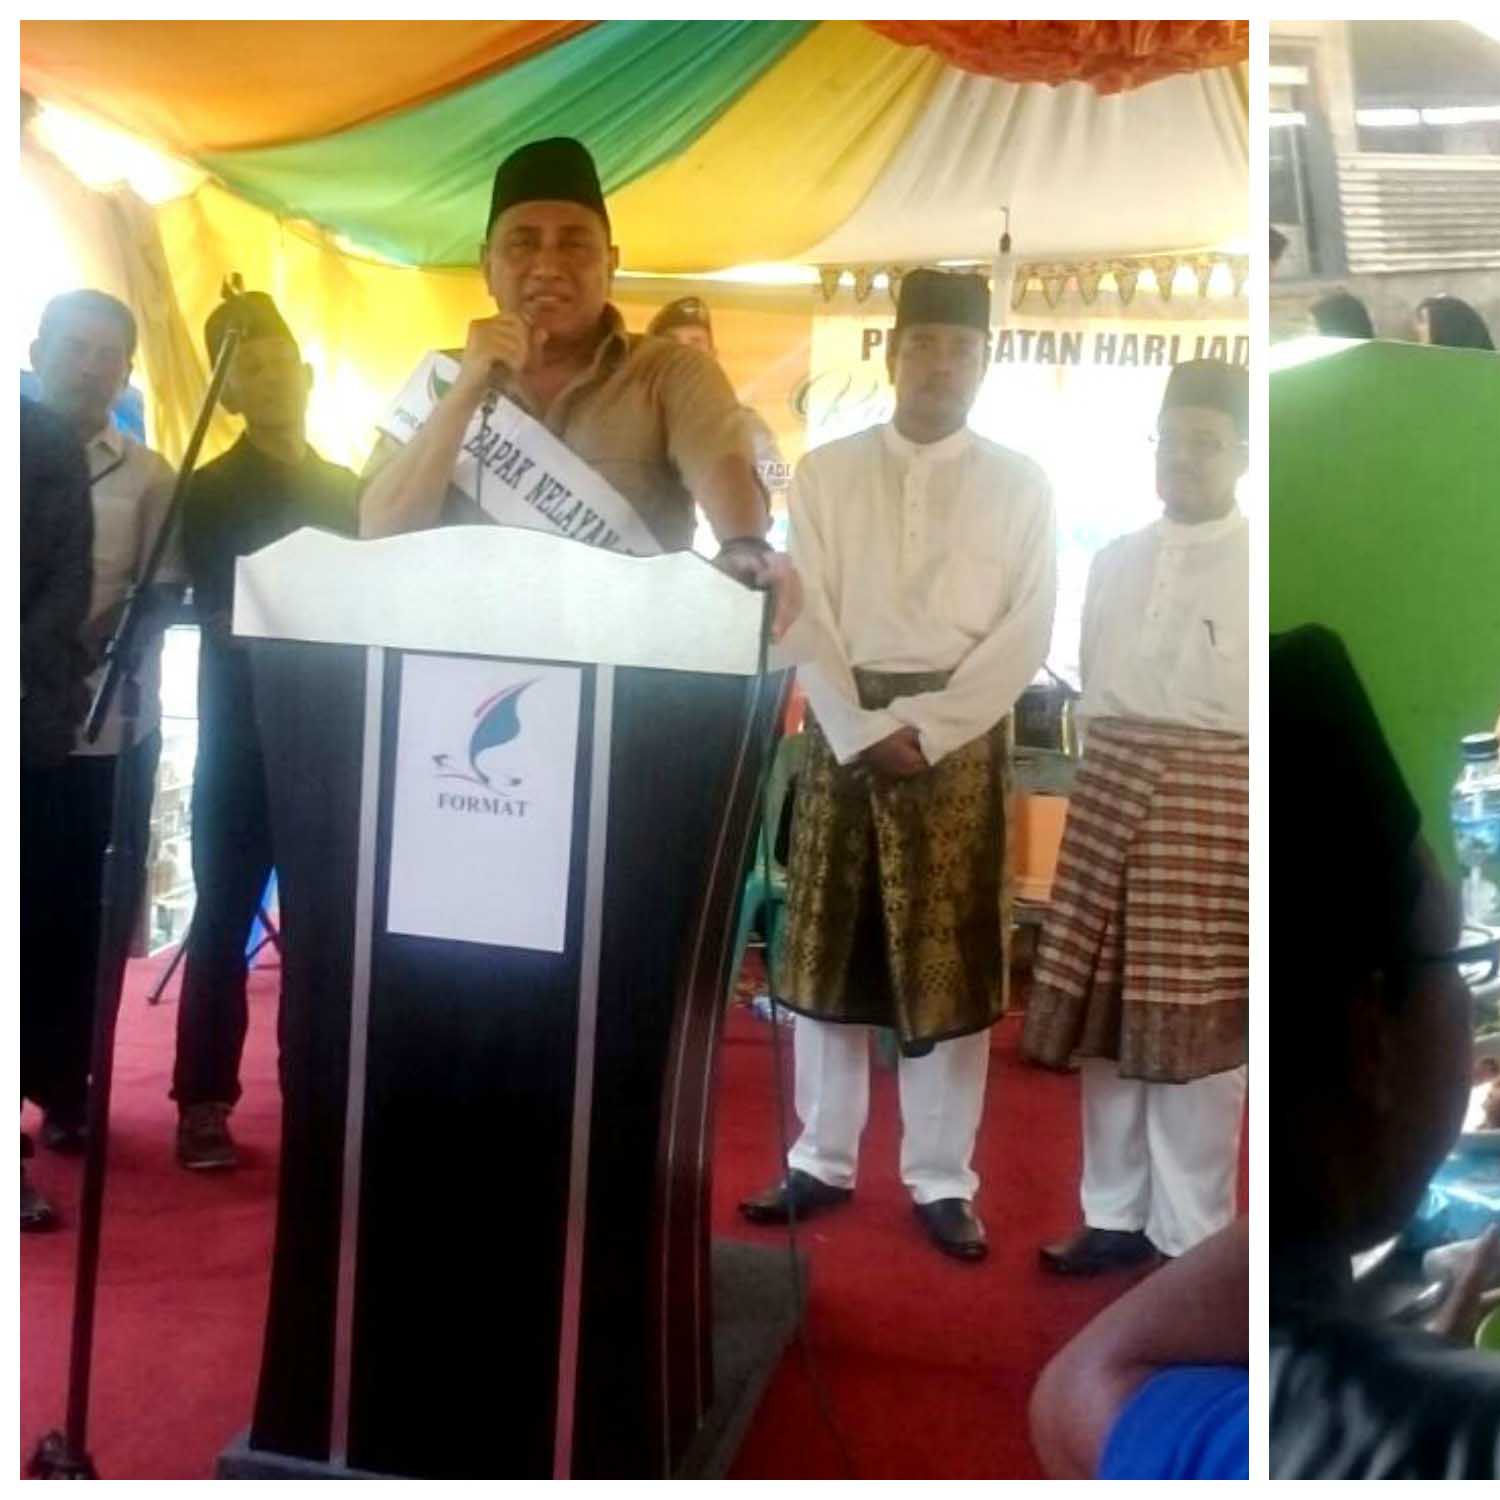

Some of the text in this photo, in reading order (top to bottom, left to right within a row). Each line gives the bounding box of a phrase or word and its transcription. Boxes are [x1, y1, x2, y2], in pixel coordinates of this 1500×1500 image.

[1094, 333, 1181, 366] HARI
[463, 424, 537, 489] BAPAK
[437, 793, 529, 817] FORMAT
